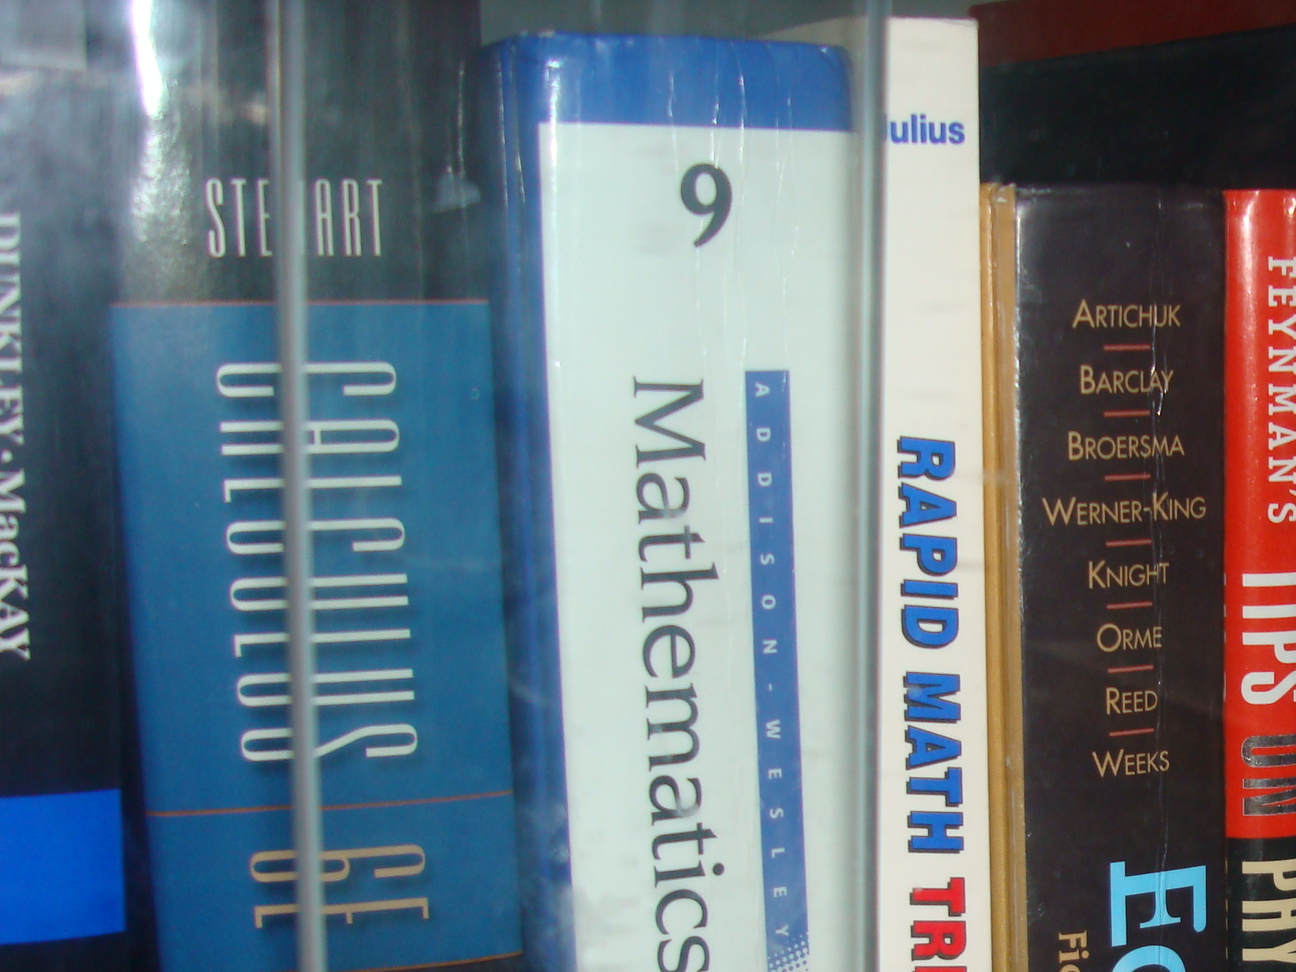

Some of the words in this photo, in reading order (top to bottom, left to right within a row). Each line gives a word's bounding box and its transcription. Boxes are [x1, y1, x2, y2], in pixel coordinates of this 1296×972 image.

[884, 113, 965, 144] ulius
[204, 178, 384, 258] STEART
[680, 163, 733, 248] 9
[1072, 299, 1181, 329] ARTICHUK
[1079, 365, 1174, 395] BARCLAY
[1067, 431, 1185, 461] BROERSMA
[1042, 492, 1207, 527] WERNER-KING
[896, 435, 959, 649] RAPID
[215, 361, 418, 762] CALCULUS
[1087, 560, 1170, 590] KNIGHT
[1096, 623, 1163, 653] ORME
[1105, 686, 1158, 716] REED
[902, 671, 965, 854] MATH
[1092, 749, 1170, 779] WEEKS
